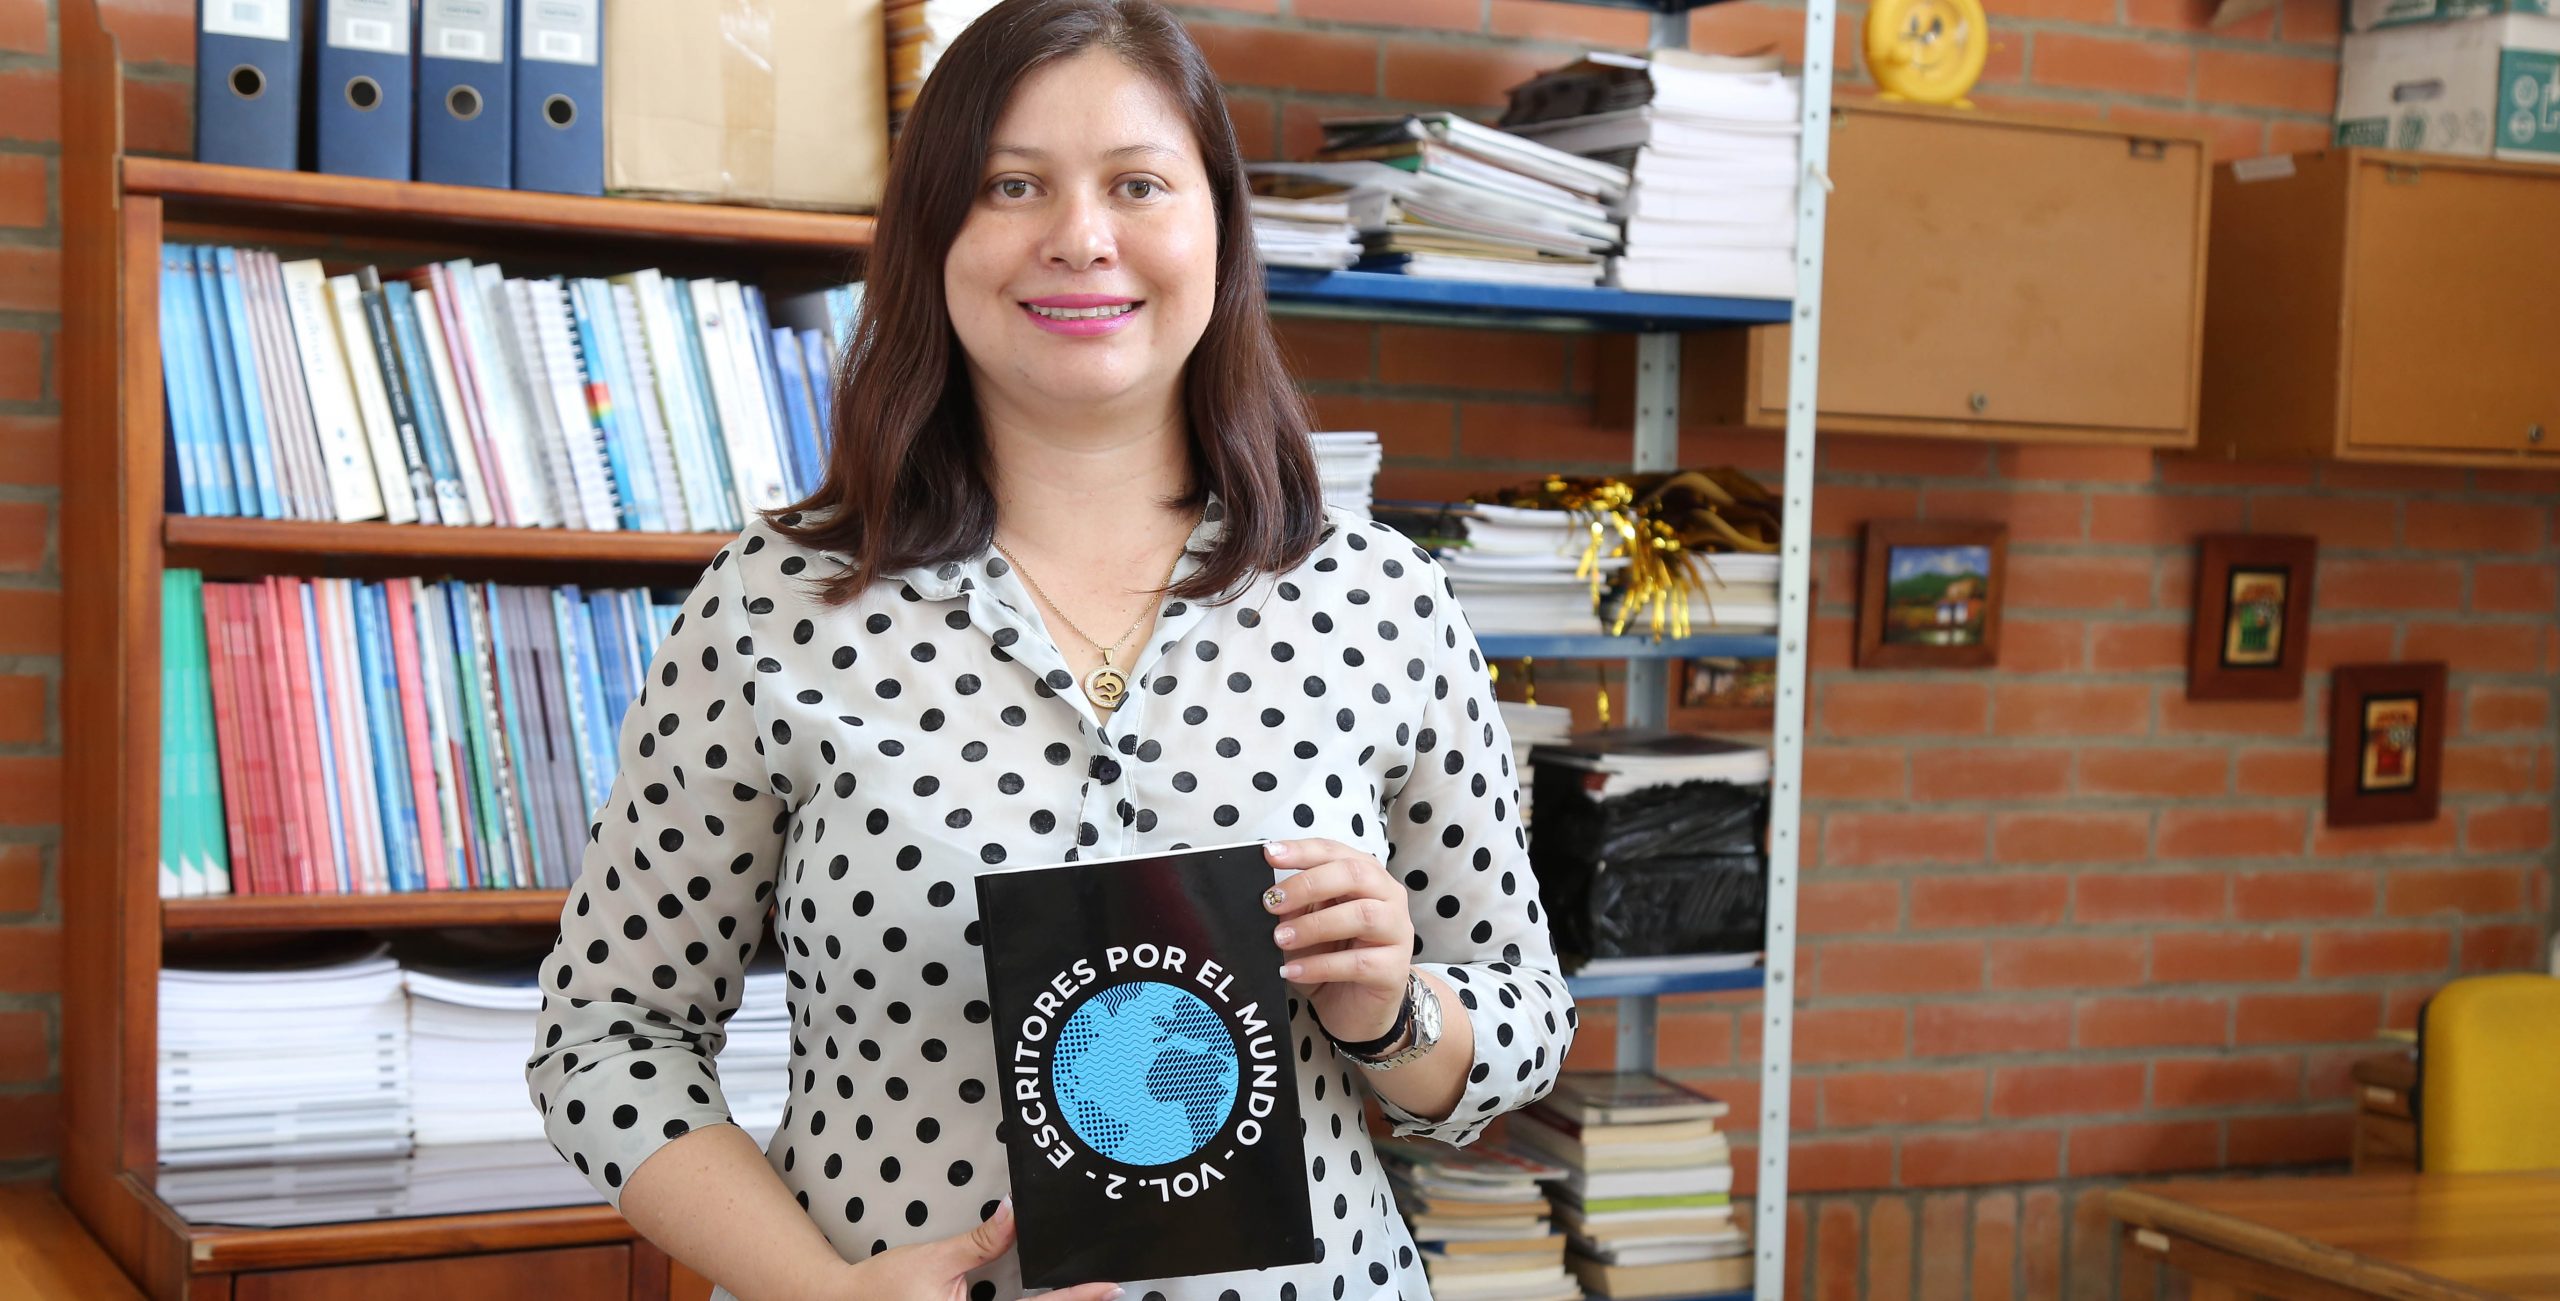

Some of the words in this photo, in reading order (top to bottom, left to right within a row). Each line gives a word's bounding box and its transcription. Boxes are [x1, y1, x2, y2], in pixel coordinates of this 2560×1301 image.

[1105, 943, 1187, 974] POR
[1195, 958, 1235, 1003] EL
[1014, 958, 1097, 1170] ESCRITORES
[1234, 1001, 1278, 1146] MUNDO
[1105, 1173, 1127, 1200] 2
[1138, 1162, 1226, 1203] VOL.
